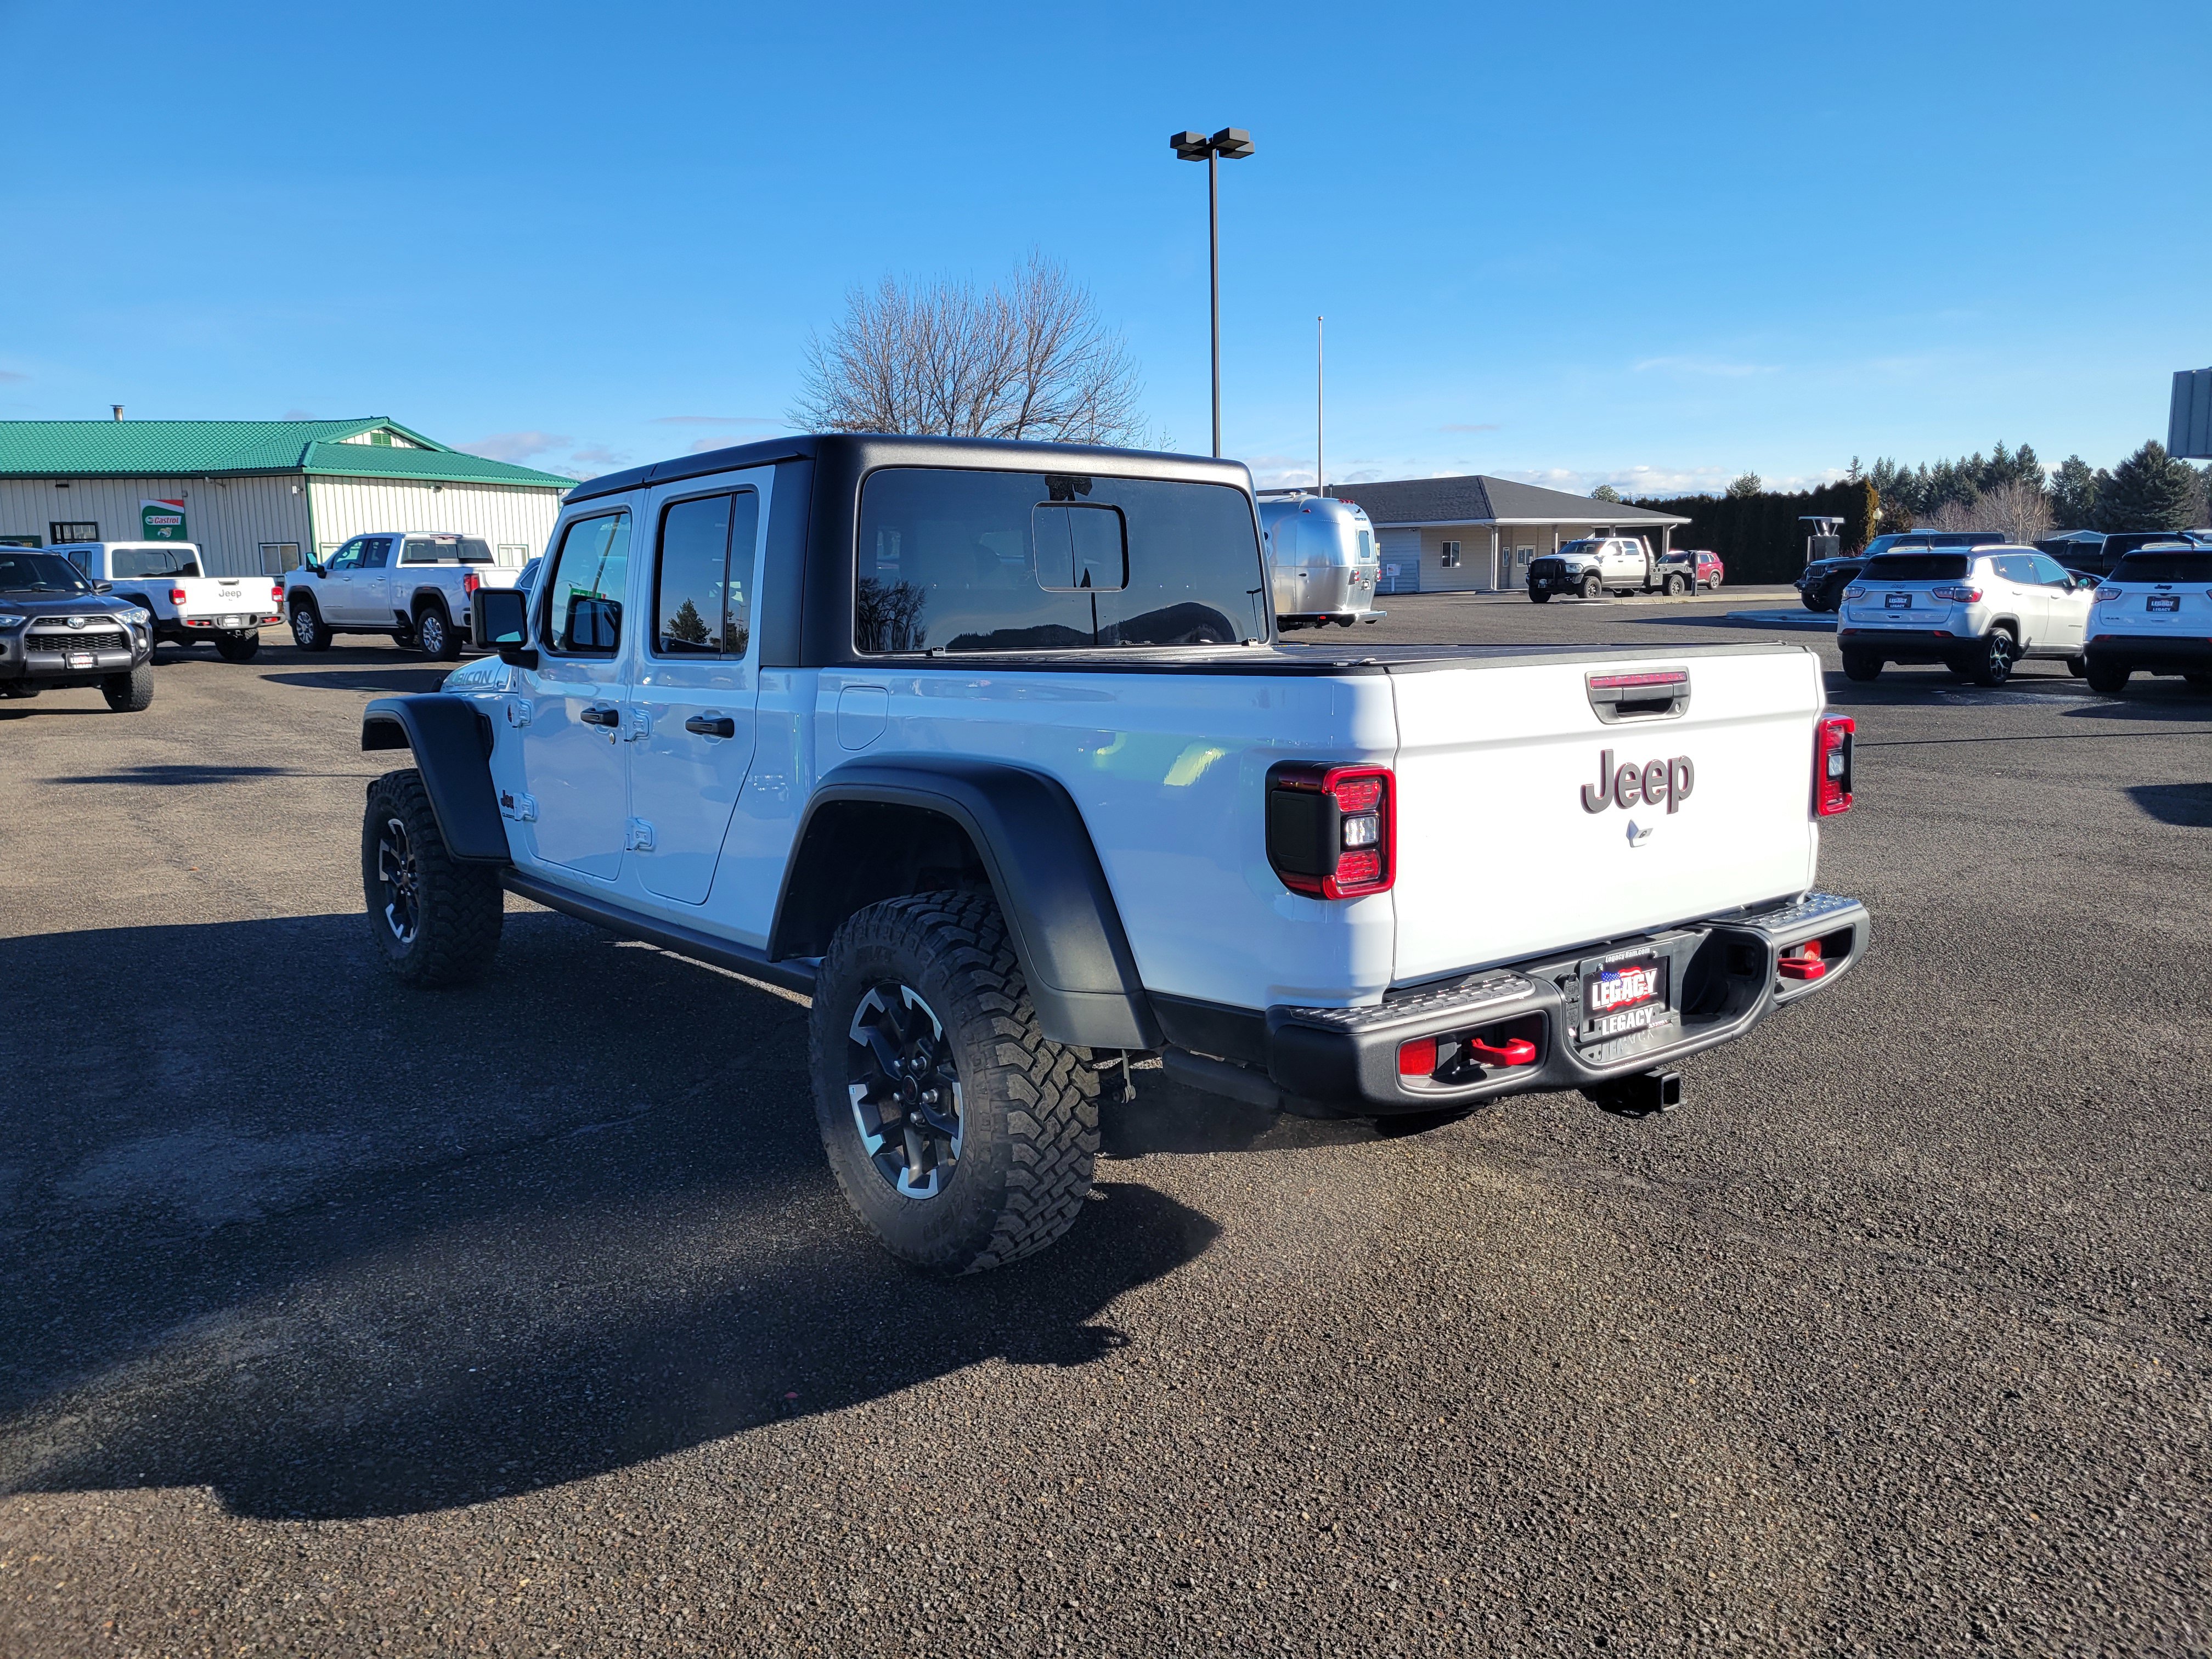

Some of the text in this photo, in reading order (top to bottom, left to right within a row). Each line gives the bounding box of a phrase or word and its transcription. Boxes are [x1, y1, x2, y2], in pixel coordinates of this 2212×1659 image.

[218, 589, 242, 599] Jeep
[1580, 748, 1694, 815] Jeep
[500, 789, 514, 809] Jee
[1592, 970, 1657, 1008] LEGACY
[1601, 1007, 1654, 1036] LEGACY
